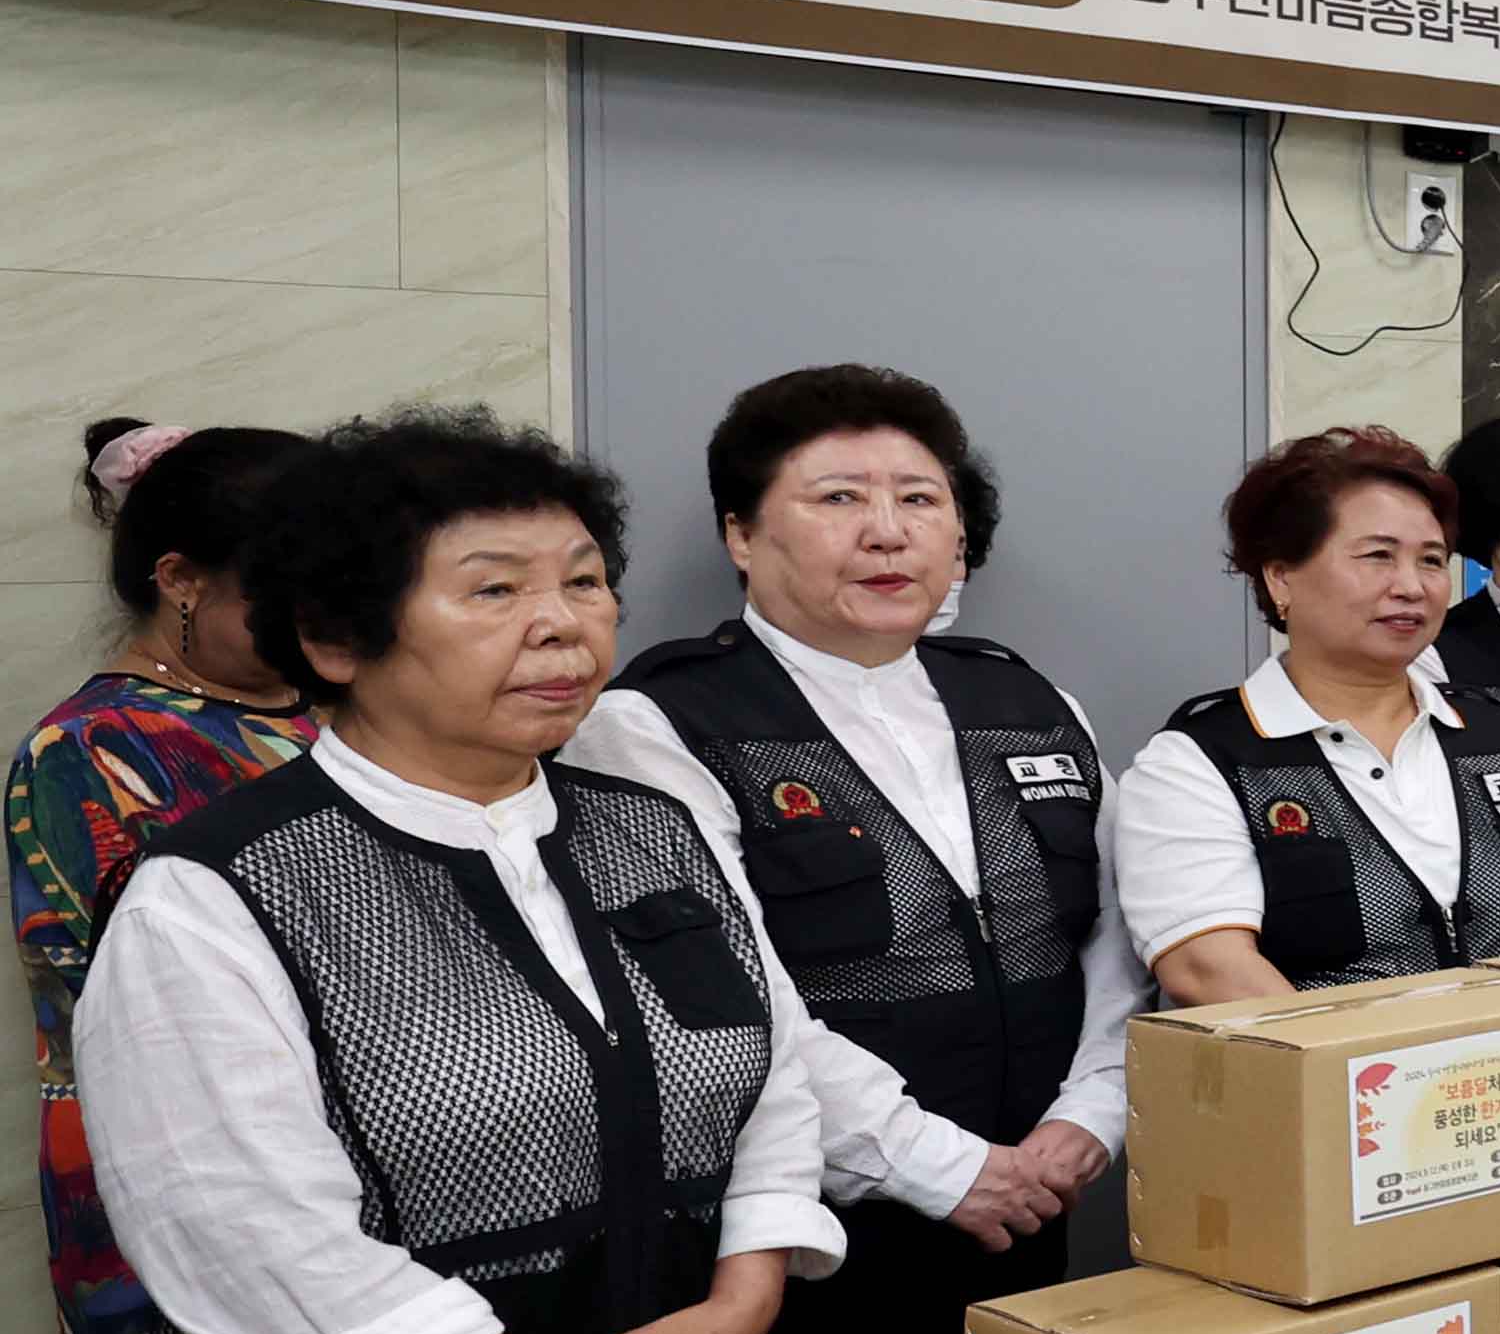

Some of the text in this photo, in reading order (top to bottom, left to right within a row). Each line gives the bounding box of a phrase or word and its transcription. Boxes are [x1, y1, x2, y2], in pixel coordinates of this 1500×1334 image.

[1015, 757, 1075, 777] 교통
[1021, 784, 1066, 801] WOMAN
[1434, 1100, 1477, 1128] 풍성한
